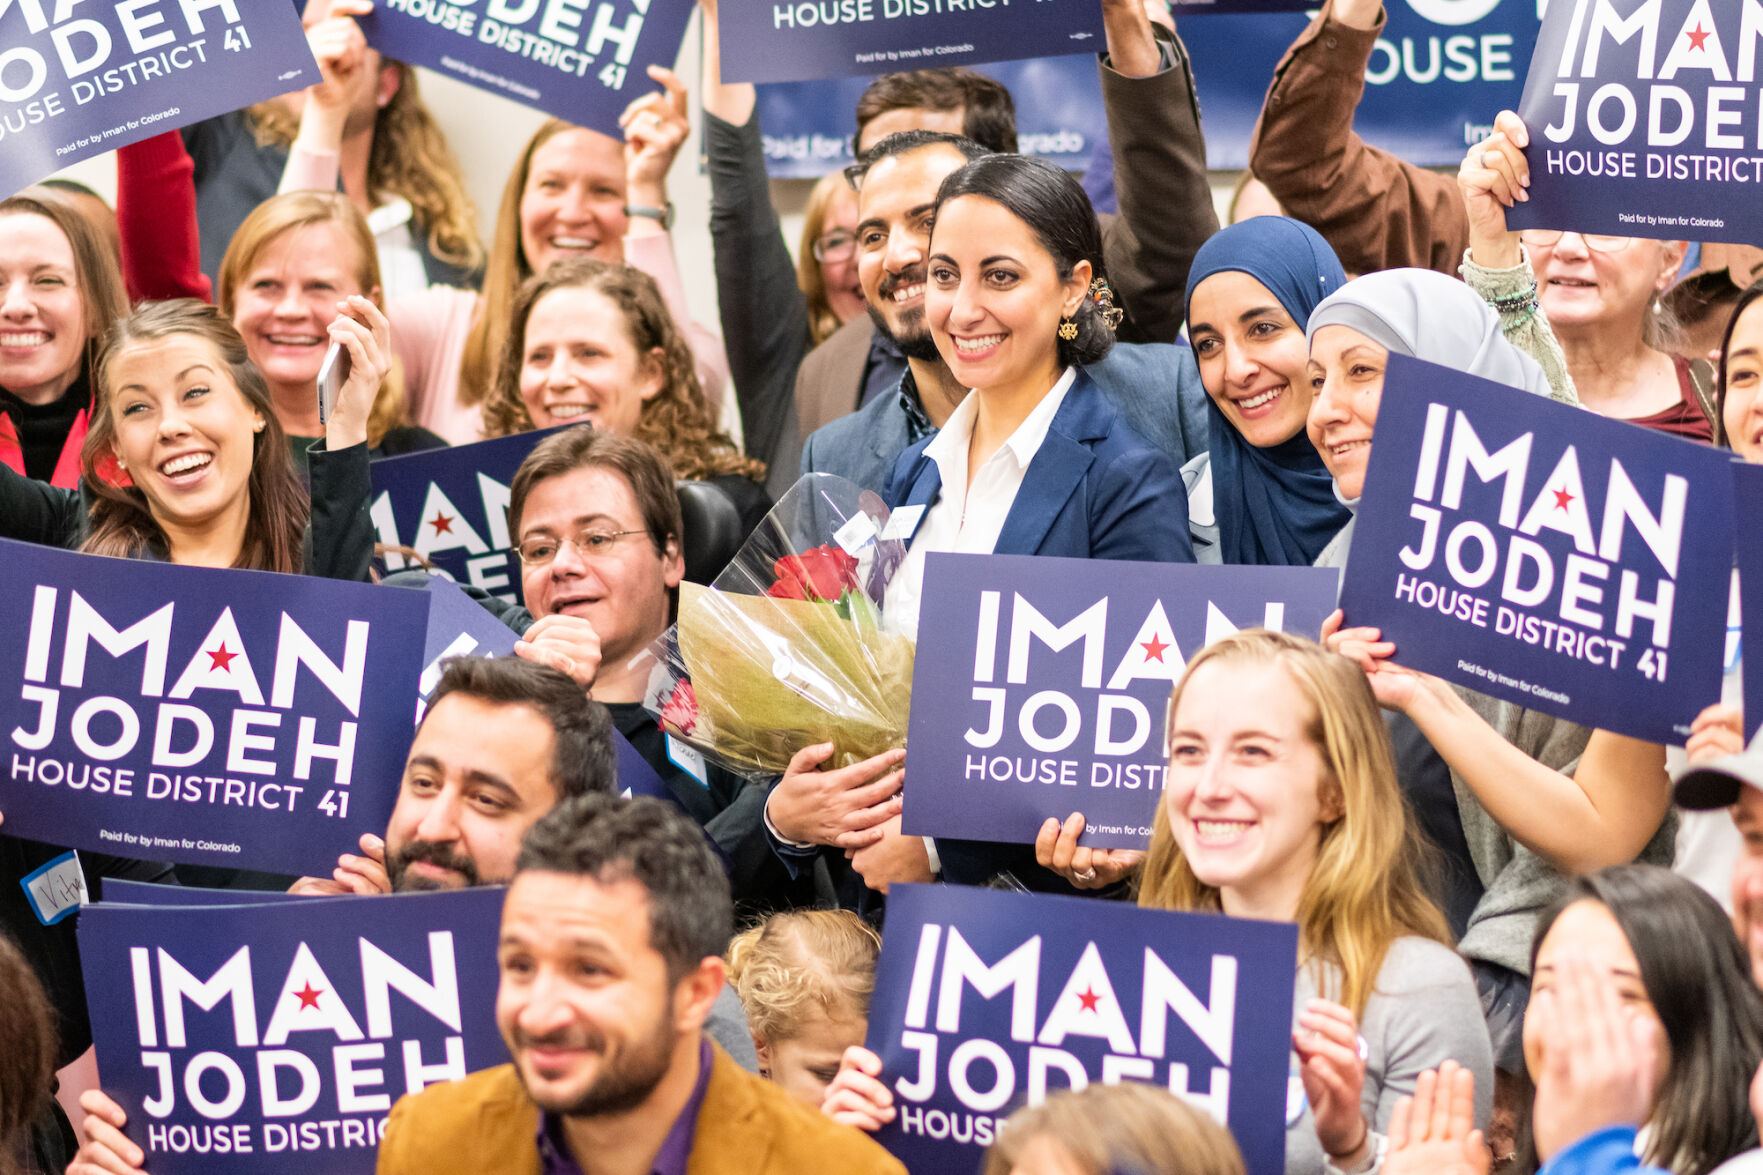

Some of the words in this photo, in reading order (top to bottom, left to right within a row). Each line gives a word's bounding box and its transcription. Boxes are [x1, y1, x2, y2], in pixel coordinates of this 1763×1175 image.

[773, 0, 874, 29] HOUSE
[0, 0, 241, 103] ODEH
[71, 39, 208, 105] DISTRICT
[223, 25, 252, 53] 41
[478, 18, 594, 77] DISTRICT
[597, 63, 628, 91] 41
[56, 142, 76, 157] Paid
[77, 139, 89, 147] for
[90, 134, 102, 143] by
[102, 125, 127, 138] Iman
[127, 120, 139, 130] for
[141, 107, 180, 125] Colorado
[1544, 83, 1763, 150] JODE
[1547, 150, 1636, 178] HOUSE
[1647, 153, 1763, 183] DISTRICT
[1619, 213, 1635, 223] Paid
[1636, 214, 1647, 223] for
[1647, 215, 1657, 226] by
[1658, 216, 1677, 225] Iman
[1678, 216, 1689, 226] for
[1690, 217, 1724, 228] Colorado
[1413, 402, 1689, 580] IMAN
[1398, 502, 1676, 648] JODEH
[24, 584, 370, 718] IMAN
[1395, 573, 1490, 628] HOUSE
[1495, 605, 1626, 670] DISTRICT
[1637, 648, 1668, 683] 41
[1457, 659, 1475, 674] Paid
[1476, 665, 1487, 677] for
[1487, 669, 1498, 683] by
[1498, 673, 1519, 688] Iman
[1519, 680, 1531, 692] for
[1532, 684, 1571, 705] Colorado
[10, 684, 358, 785] JODEH
[963, 686, 1170, 758] JOD
[11, 753, 135, 797] HOUSE
[146, 772, 304, 812] DISTRICT
[317, 789, 350, 818] 41
[965, 754, 1079, 786] HOUSE
[1091, 761, 1168, 790] DIST
[100, 829, 122, 841] Paid
[123, 832, 138, 844] for
[140, 834, 152, 847] by
[154, 836, 180, 848] Iman
[181, 838, 195, 849] for
[197, 840, 241, 853] Colorado
[1085, 823, 1097, 834] by
[1099, 823, 1122, 834] Iman
[1124, 825, 1137, 835] for
[130, 930, 463, 1047] IMAN
[904, 923, 1237, 1066] IMAN
[141, 1036, 467, 1119] JODEH
[148, 1124, 253, 1153] HOUSE
